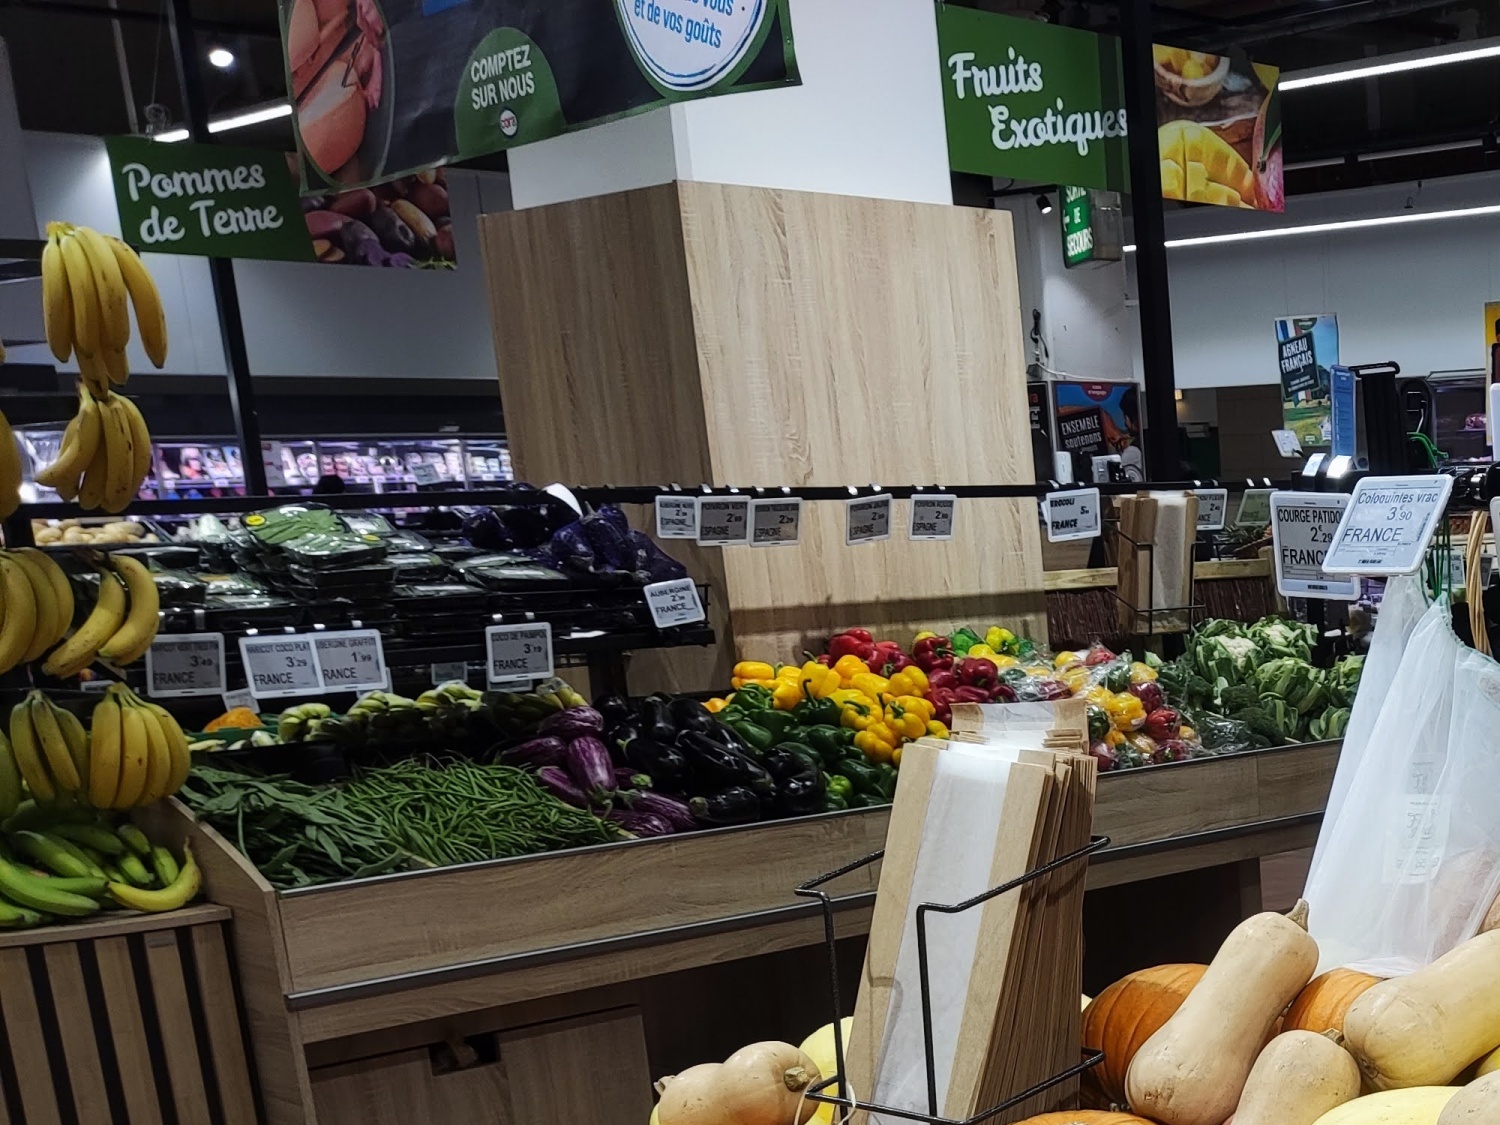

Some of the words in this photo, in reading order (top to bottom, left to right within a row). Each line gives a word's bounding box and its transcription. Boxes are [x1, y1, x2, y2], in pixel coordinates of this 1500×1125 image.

[634, 0, 645, 19] et
[647, 0, 660, 25] de
[663, 9, 683, 33] vos
[685, 18, 722, 48] goûts
[471, 44, 531, 82] COMPTEZ
[948, 46, 1044, 99] Fruits
[471, 83, 498, 110] SUR
[499, 71, 535, 103] NOUS
[987, 97, 1128, 156] Exotiques
[122, 163, 266, 201] Pommes
[140, 205, 185, 244] de
[189, 199, 284, 237] Terre
[1282, 337, 1308, 359] AGNEAU
[1281, 350, 1314, 374] FRANÇAIS
[1061, 415, 1100, 436] ENSEMBLE
[1065, 432, 1102, 449] soutenons
[1357, 490, 1414, 505] Coloquintes
[1417, 491, 1438, 503] vrac
[1051, 518, 1079, 531] FRANCE
[1198, 513, 1212, 522] ANCE
[1278, 509, 1311, 523] COURGE
[1312, 510, 1344, 524] PATIDO
[1342, 527, 1404, 543] FRANCE
[1282, 548, 1328, 566] FRANC
[650, 584, 691, 598] AUBERGINE
[655, 602, 688, 614] FRANCE
[494, 657, 529, 670] FRANCE
[153, 671, 196, 685] FRANCE
[254, 671, 295, 686] FRANCE
[322, 667, 358, 680] RANCE
